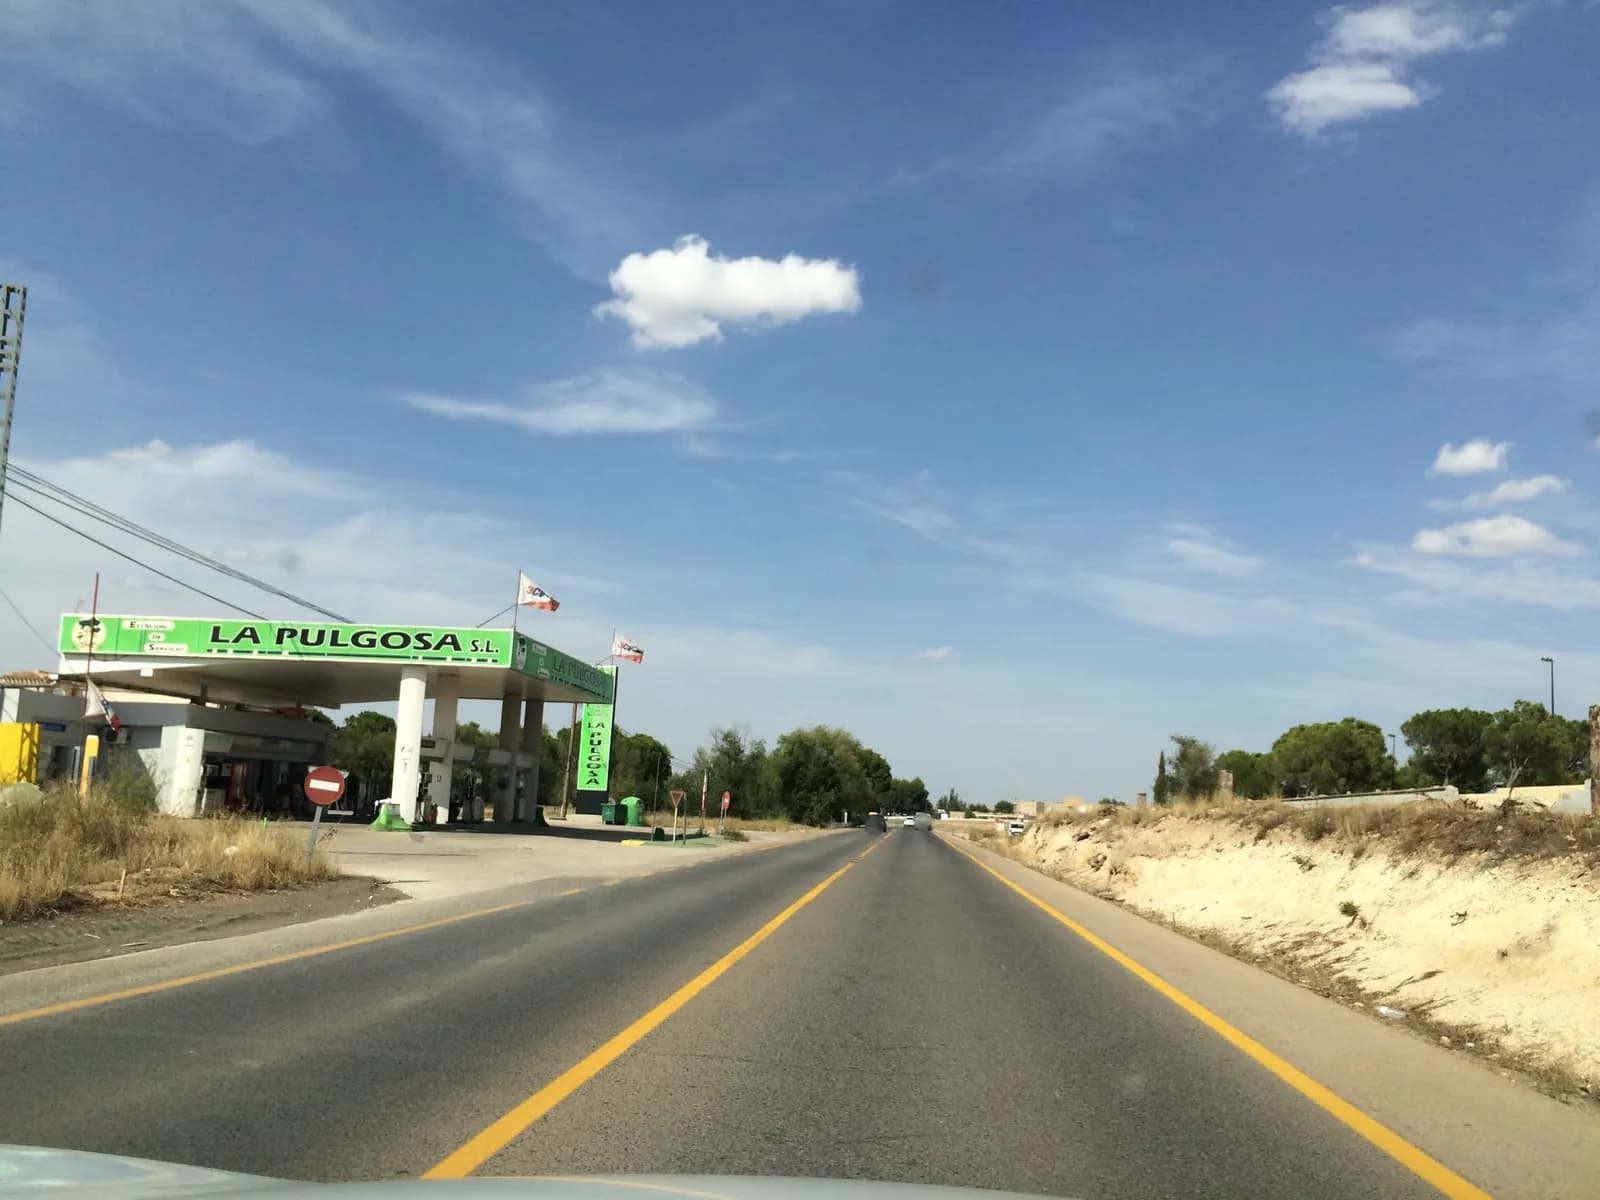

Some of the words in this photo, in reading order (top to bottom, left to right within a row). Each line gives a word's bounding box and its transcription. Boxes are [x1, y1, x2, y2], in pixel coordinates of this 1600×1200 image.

[210, 625, 261, 644] LA
[275, 627, 462, 652] PULGOSA
[470, 639, 499, 653] S.L.
[553, 655, 565, 673] LA
[568, 661, 607, 688] PULGOSA
[586, 732, 602, 785] PULGOSA
